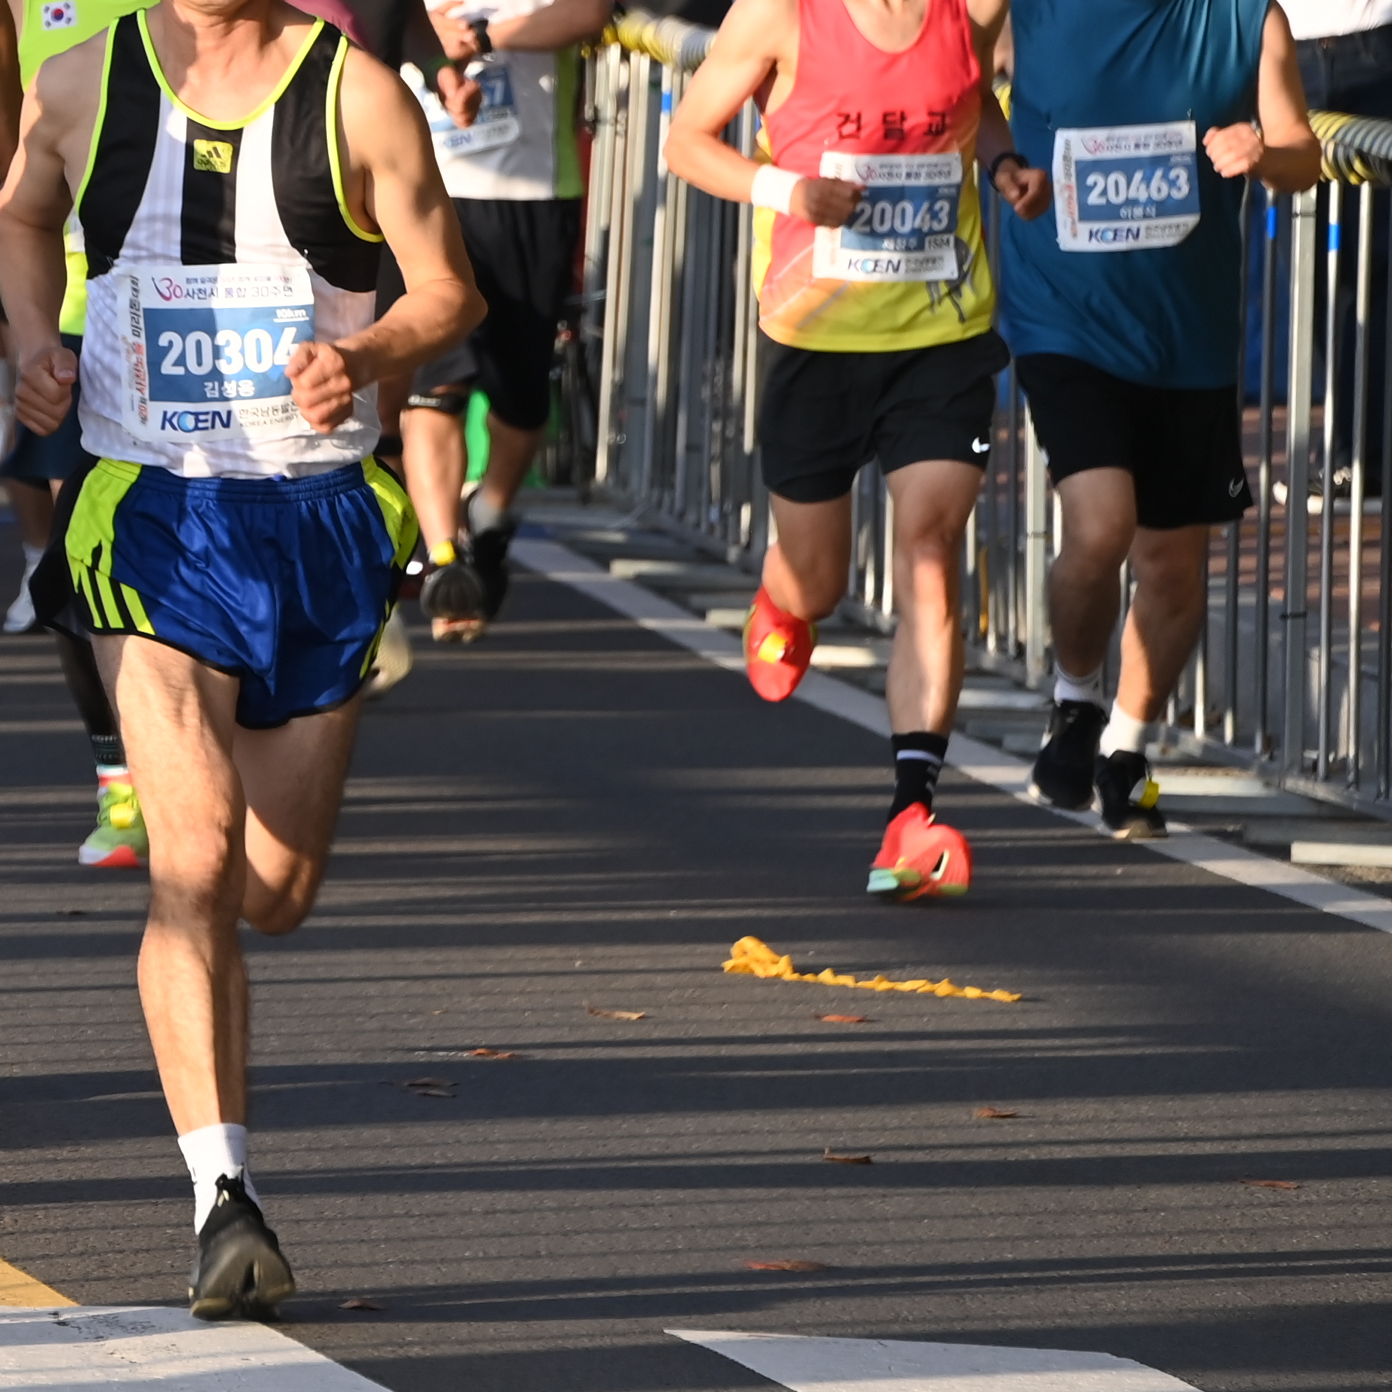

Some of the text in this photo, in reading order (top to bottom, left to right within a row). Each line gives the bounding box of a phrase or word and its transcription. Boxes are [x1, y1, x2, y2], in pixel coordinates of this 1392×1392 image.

[1085, 165, 1191, 206] 20463
[851, 199, 951, 234] 20043
[158, 326, 300, 376] 20304
[160, 410, 232, 433] KOEN
